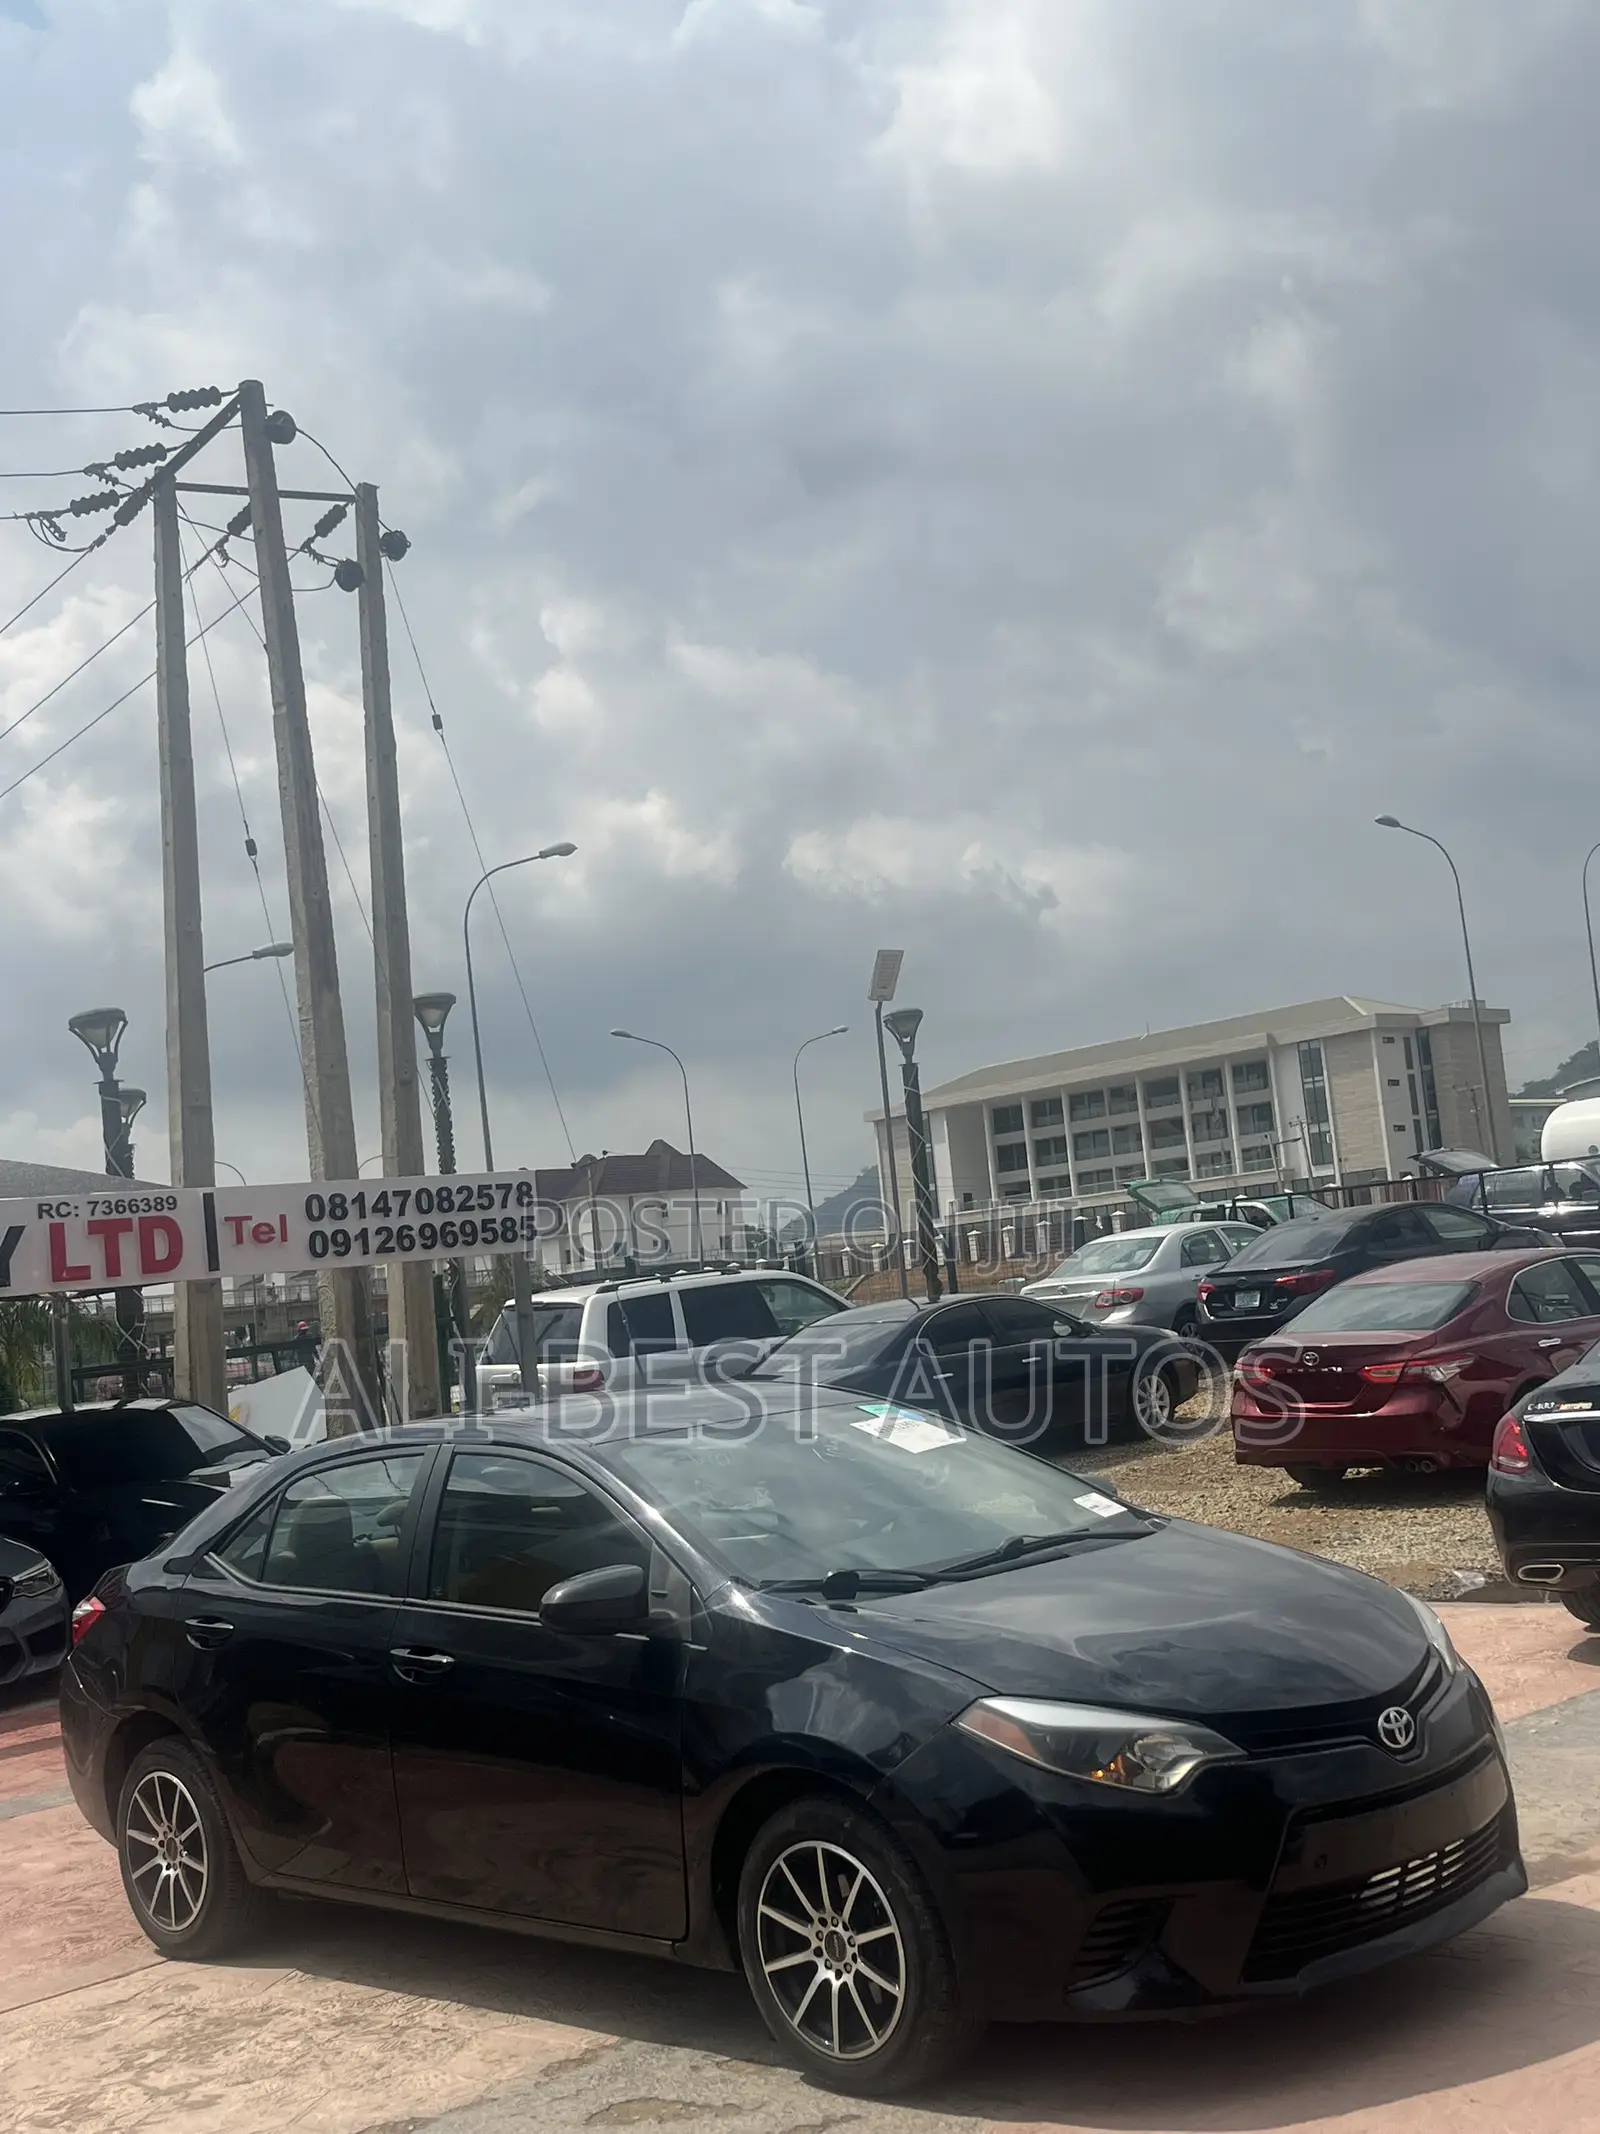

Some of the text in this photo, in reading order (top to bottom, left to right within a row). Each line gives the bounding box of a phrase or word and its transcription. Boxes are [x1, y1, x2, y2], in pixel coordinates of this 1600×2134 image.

[38, 1195, 178, 1219] RC: 7366389
[224, 1181, 533, 1245] Tel 08147082578
[49, 1215, 183, 1282] LTD
[308, 1215, 537, 1258] 09126969585
